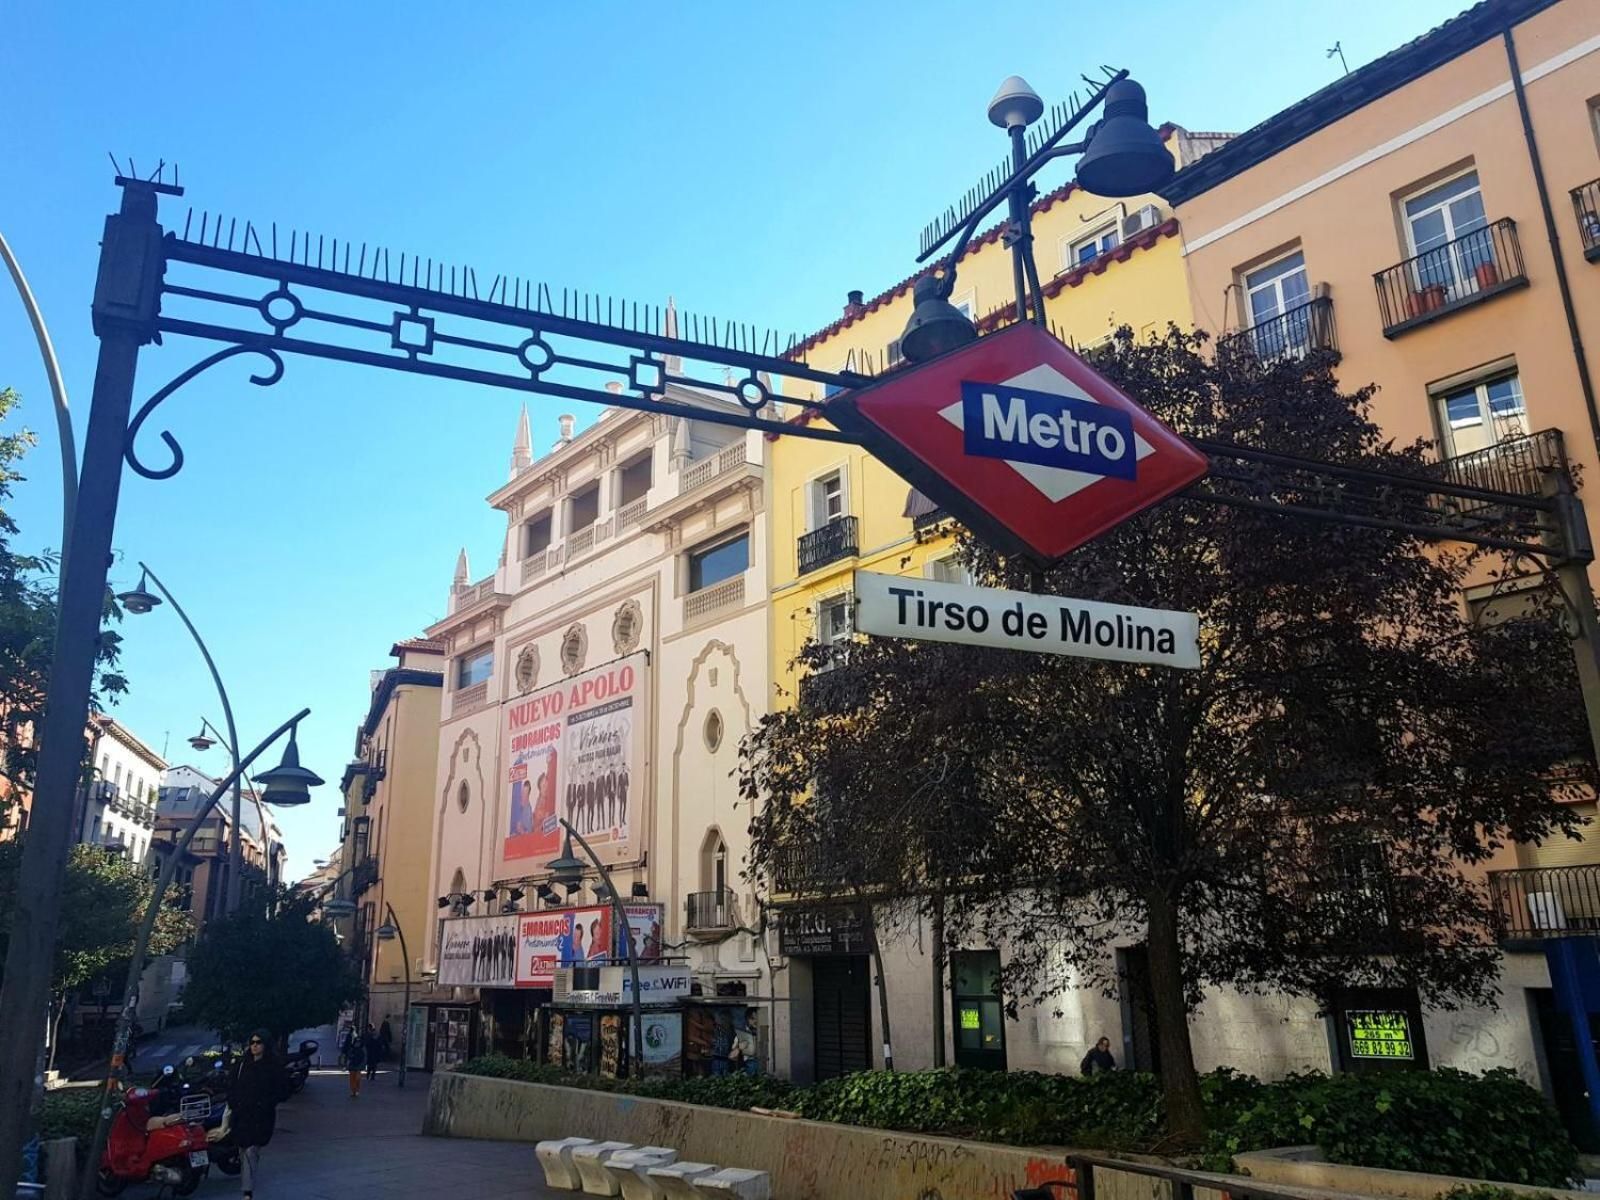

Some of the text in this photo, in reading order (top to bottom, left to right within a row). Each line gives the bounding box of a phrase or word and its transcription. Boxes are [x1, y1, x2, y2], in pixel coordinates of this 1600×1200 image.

[981, 393, 1126, 462] Metro
[888, 587, 1176, 654] Tirso de Molina
[508, 690, 564, 730] NUEVO
[567, 665, 634, 710] APOLO
[527, 918, 570, 936] MORANCOS
[623, 978, 651, 992] Fee
[661, 977, 687, 990] WiFi
[1372, 1041, 1383, 1055] 82
[1385, 1041, 1396, 1055] 99
